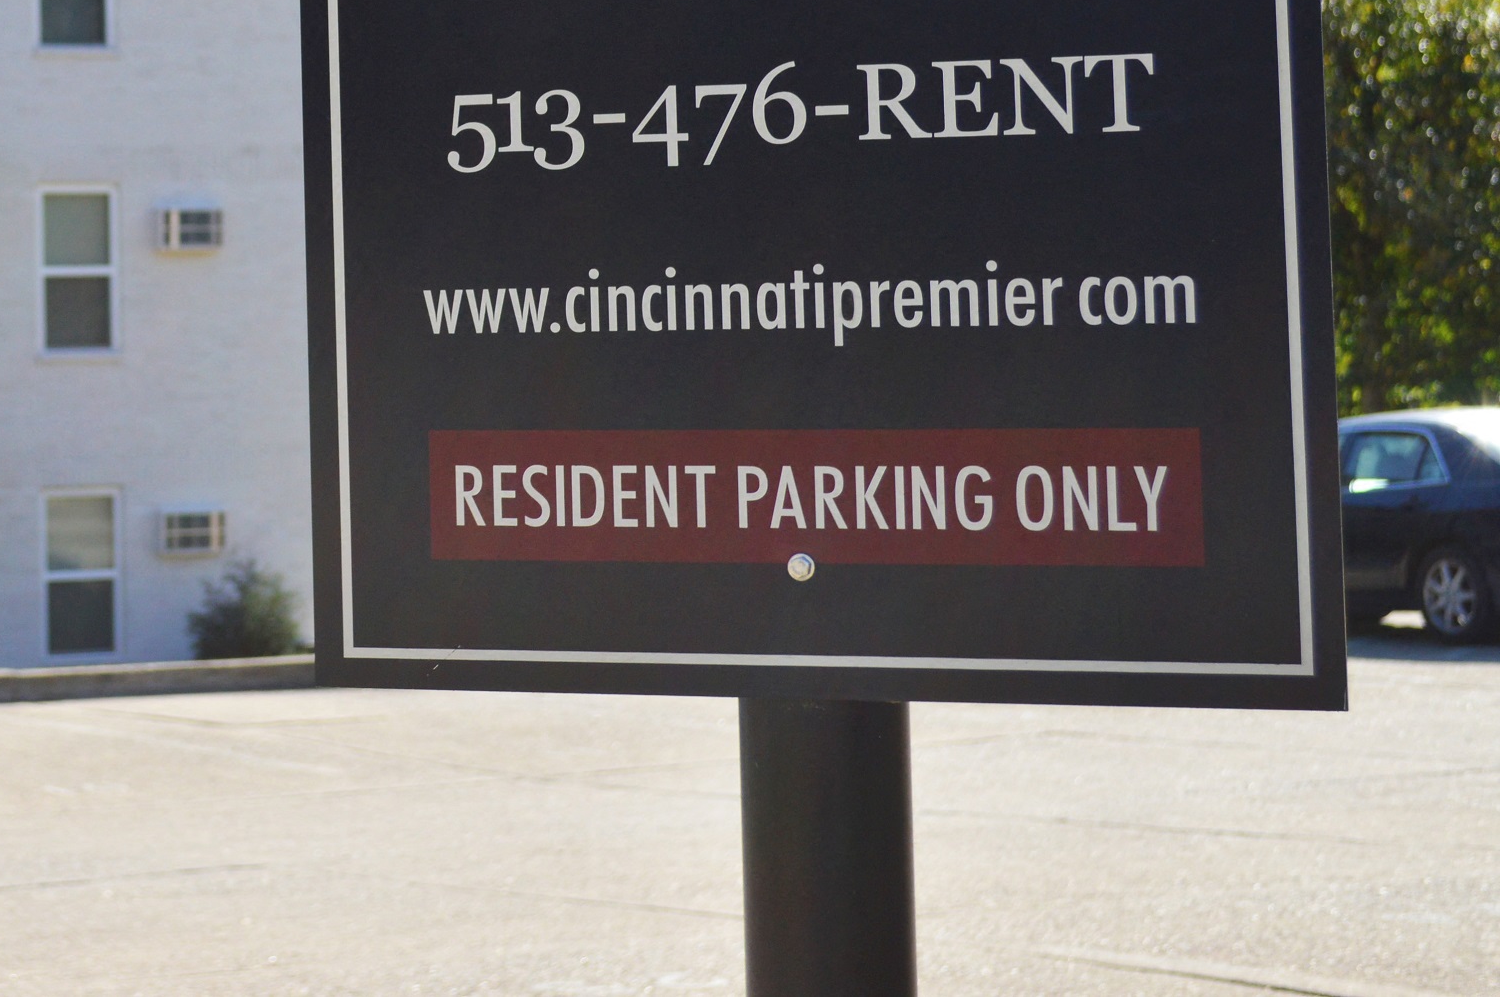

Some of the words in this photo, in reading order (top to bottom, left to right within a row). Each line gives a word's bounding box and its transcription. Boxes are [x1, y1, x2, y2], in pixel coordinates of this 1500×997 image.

[447, 53, 1155, 174] 513-476-RENT
[454, 464, 717, 529] RESIDENT
[737, 465, 994, 533] PARKING
[1015, 465, 1169, 533] ONLY
